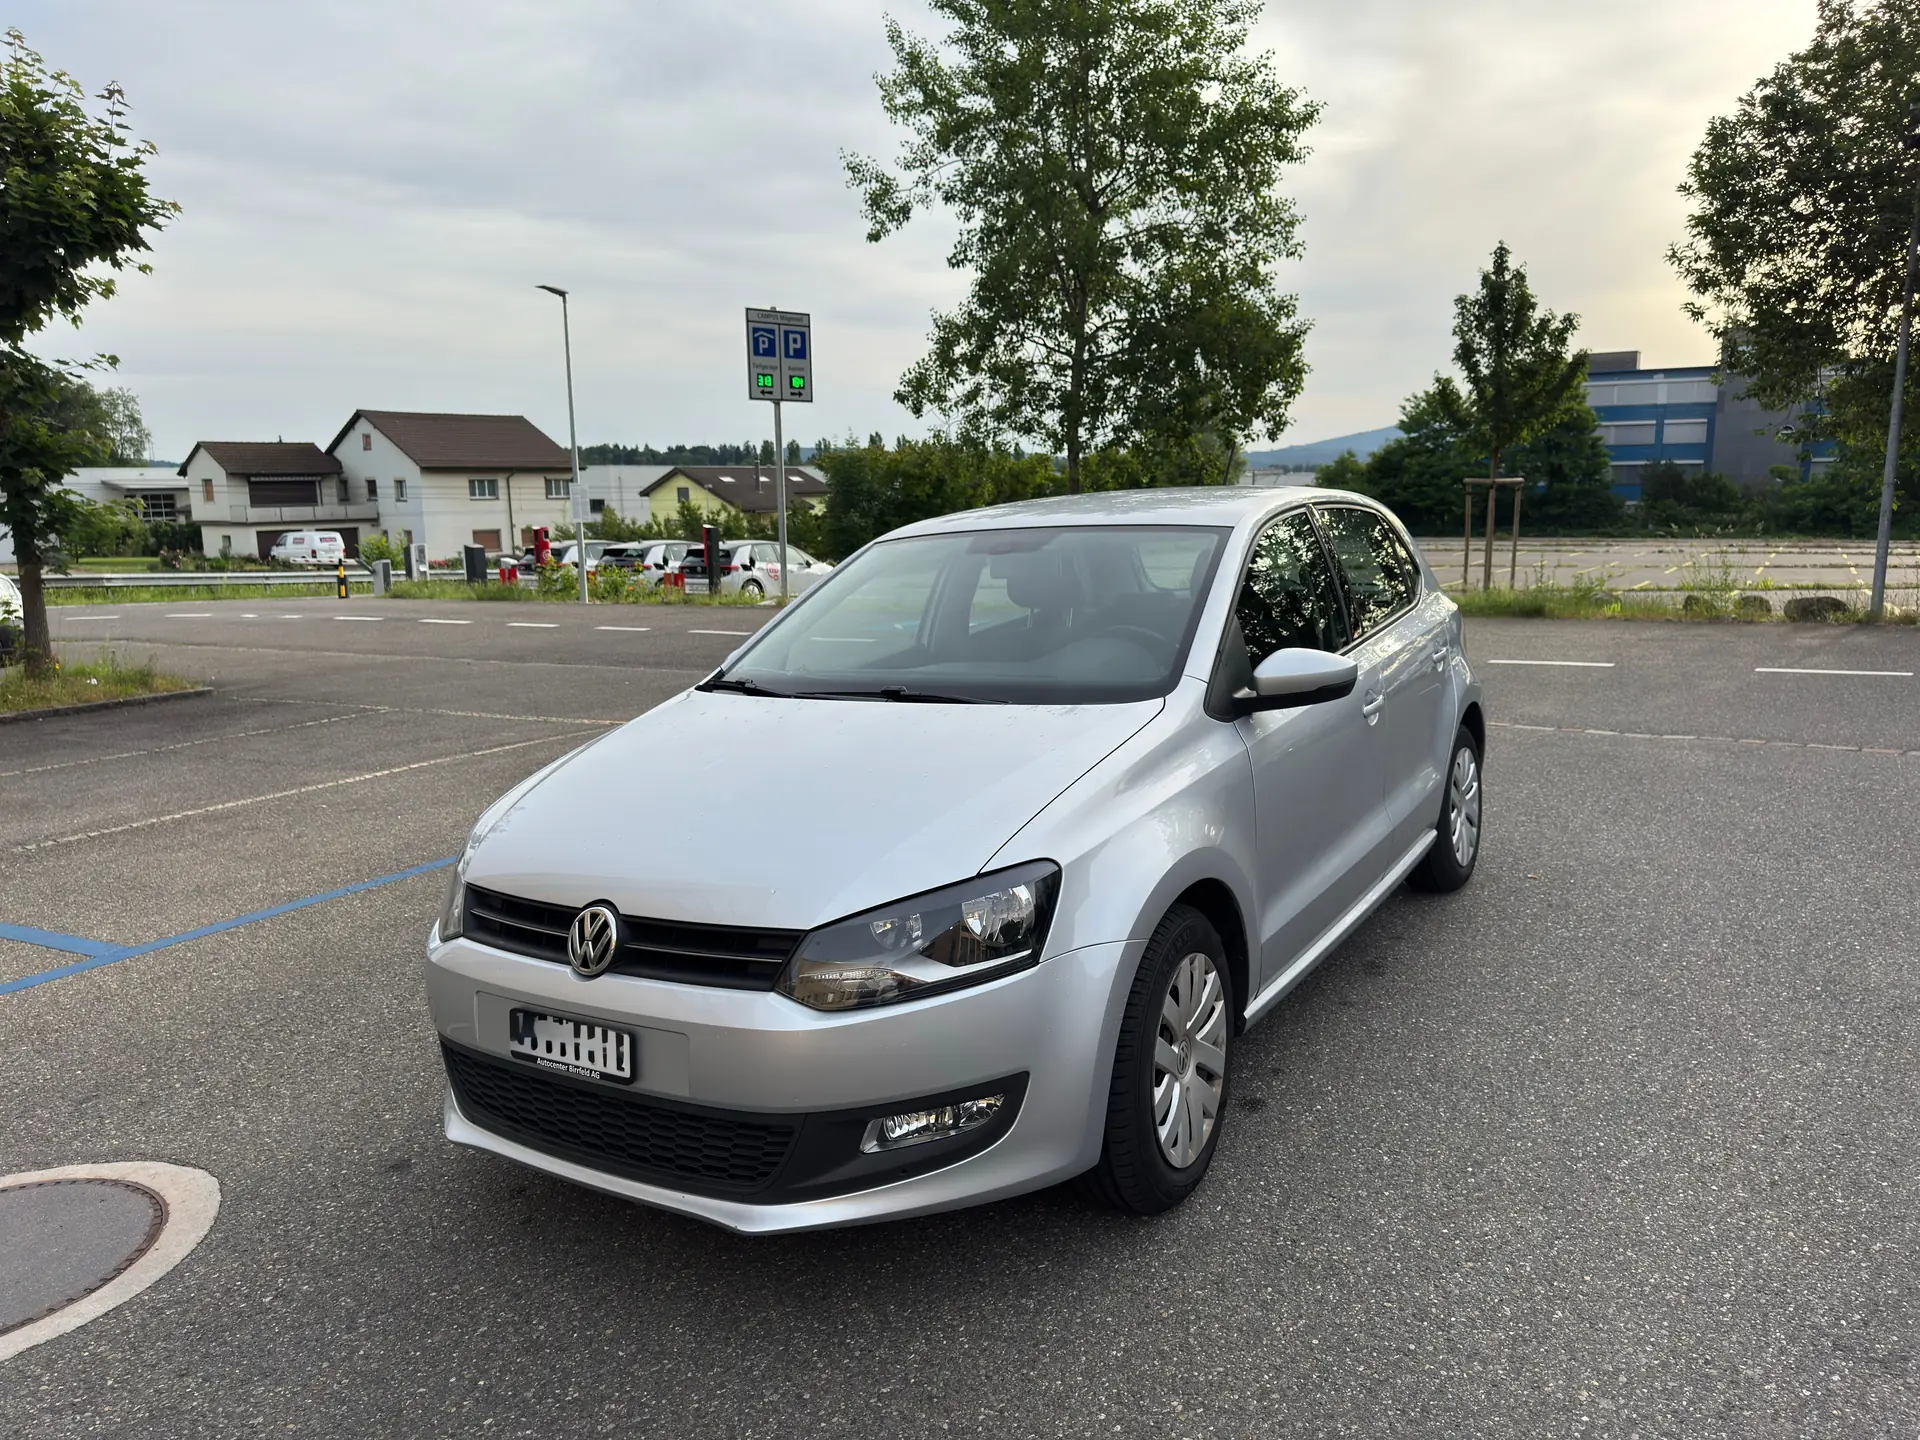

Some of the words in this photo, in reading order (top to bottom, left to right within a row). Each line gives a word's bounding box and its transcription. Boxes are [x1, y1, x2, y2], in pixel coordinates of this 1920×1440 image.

[759, 337, 768, 353] P
[789, 334, 801, 356] P
[570, 909, 614, 973] VW
[537, 1058, 568, 1071] Autocenter
[569, 1065, 590, 1078] Birrfeld
[591, 1071, 600, 1080] AG
